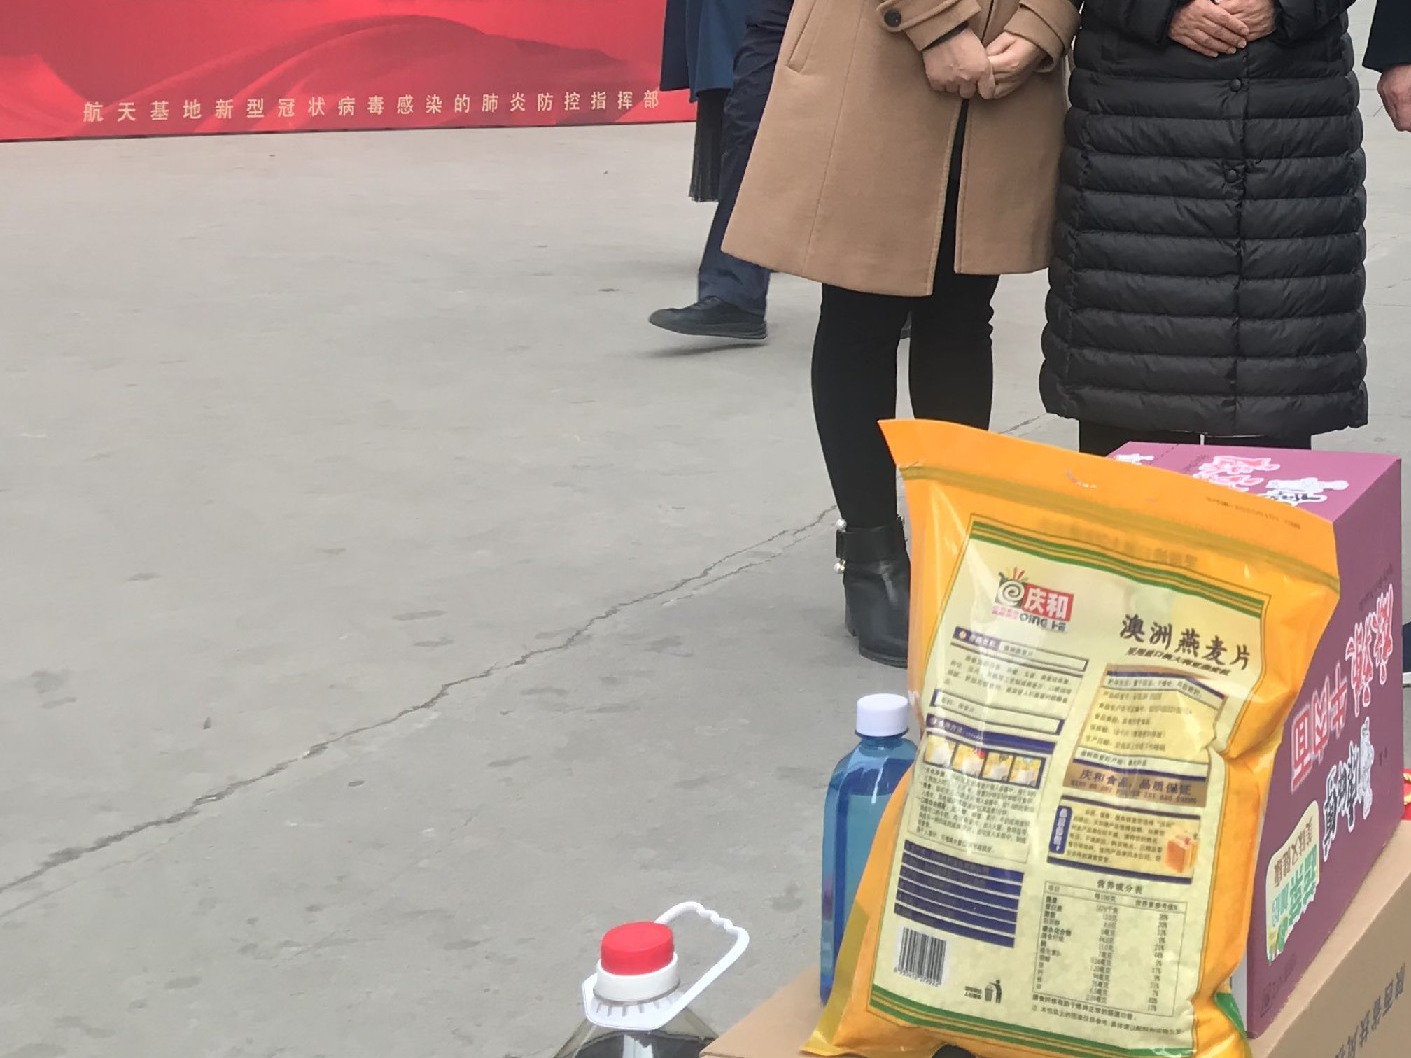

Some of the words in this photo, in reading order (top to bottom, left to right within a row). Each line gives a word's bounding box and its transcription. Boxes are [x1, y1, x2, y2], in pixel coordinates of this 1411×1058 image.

[83, 88, 661, 122] 航天基地新型冠状病毒感染的肺炎防控指挥部
[1023, 587, 1070, 620] 庆和
[1120, 614, 1250, 671] 澳洲燕麦片
